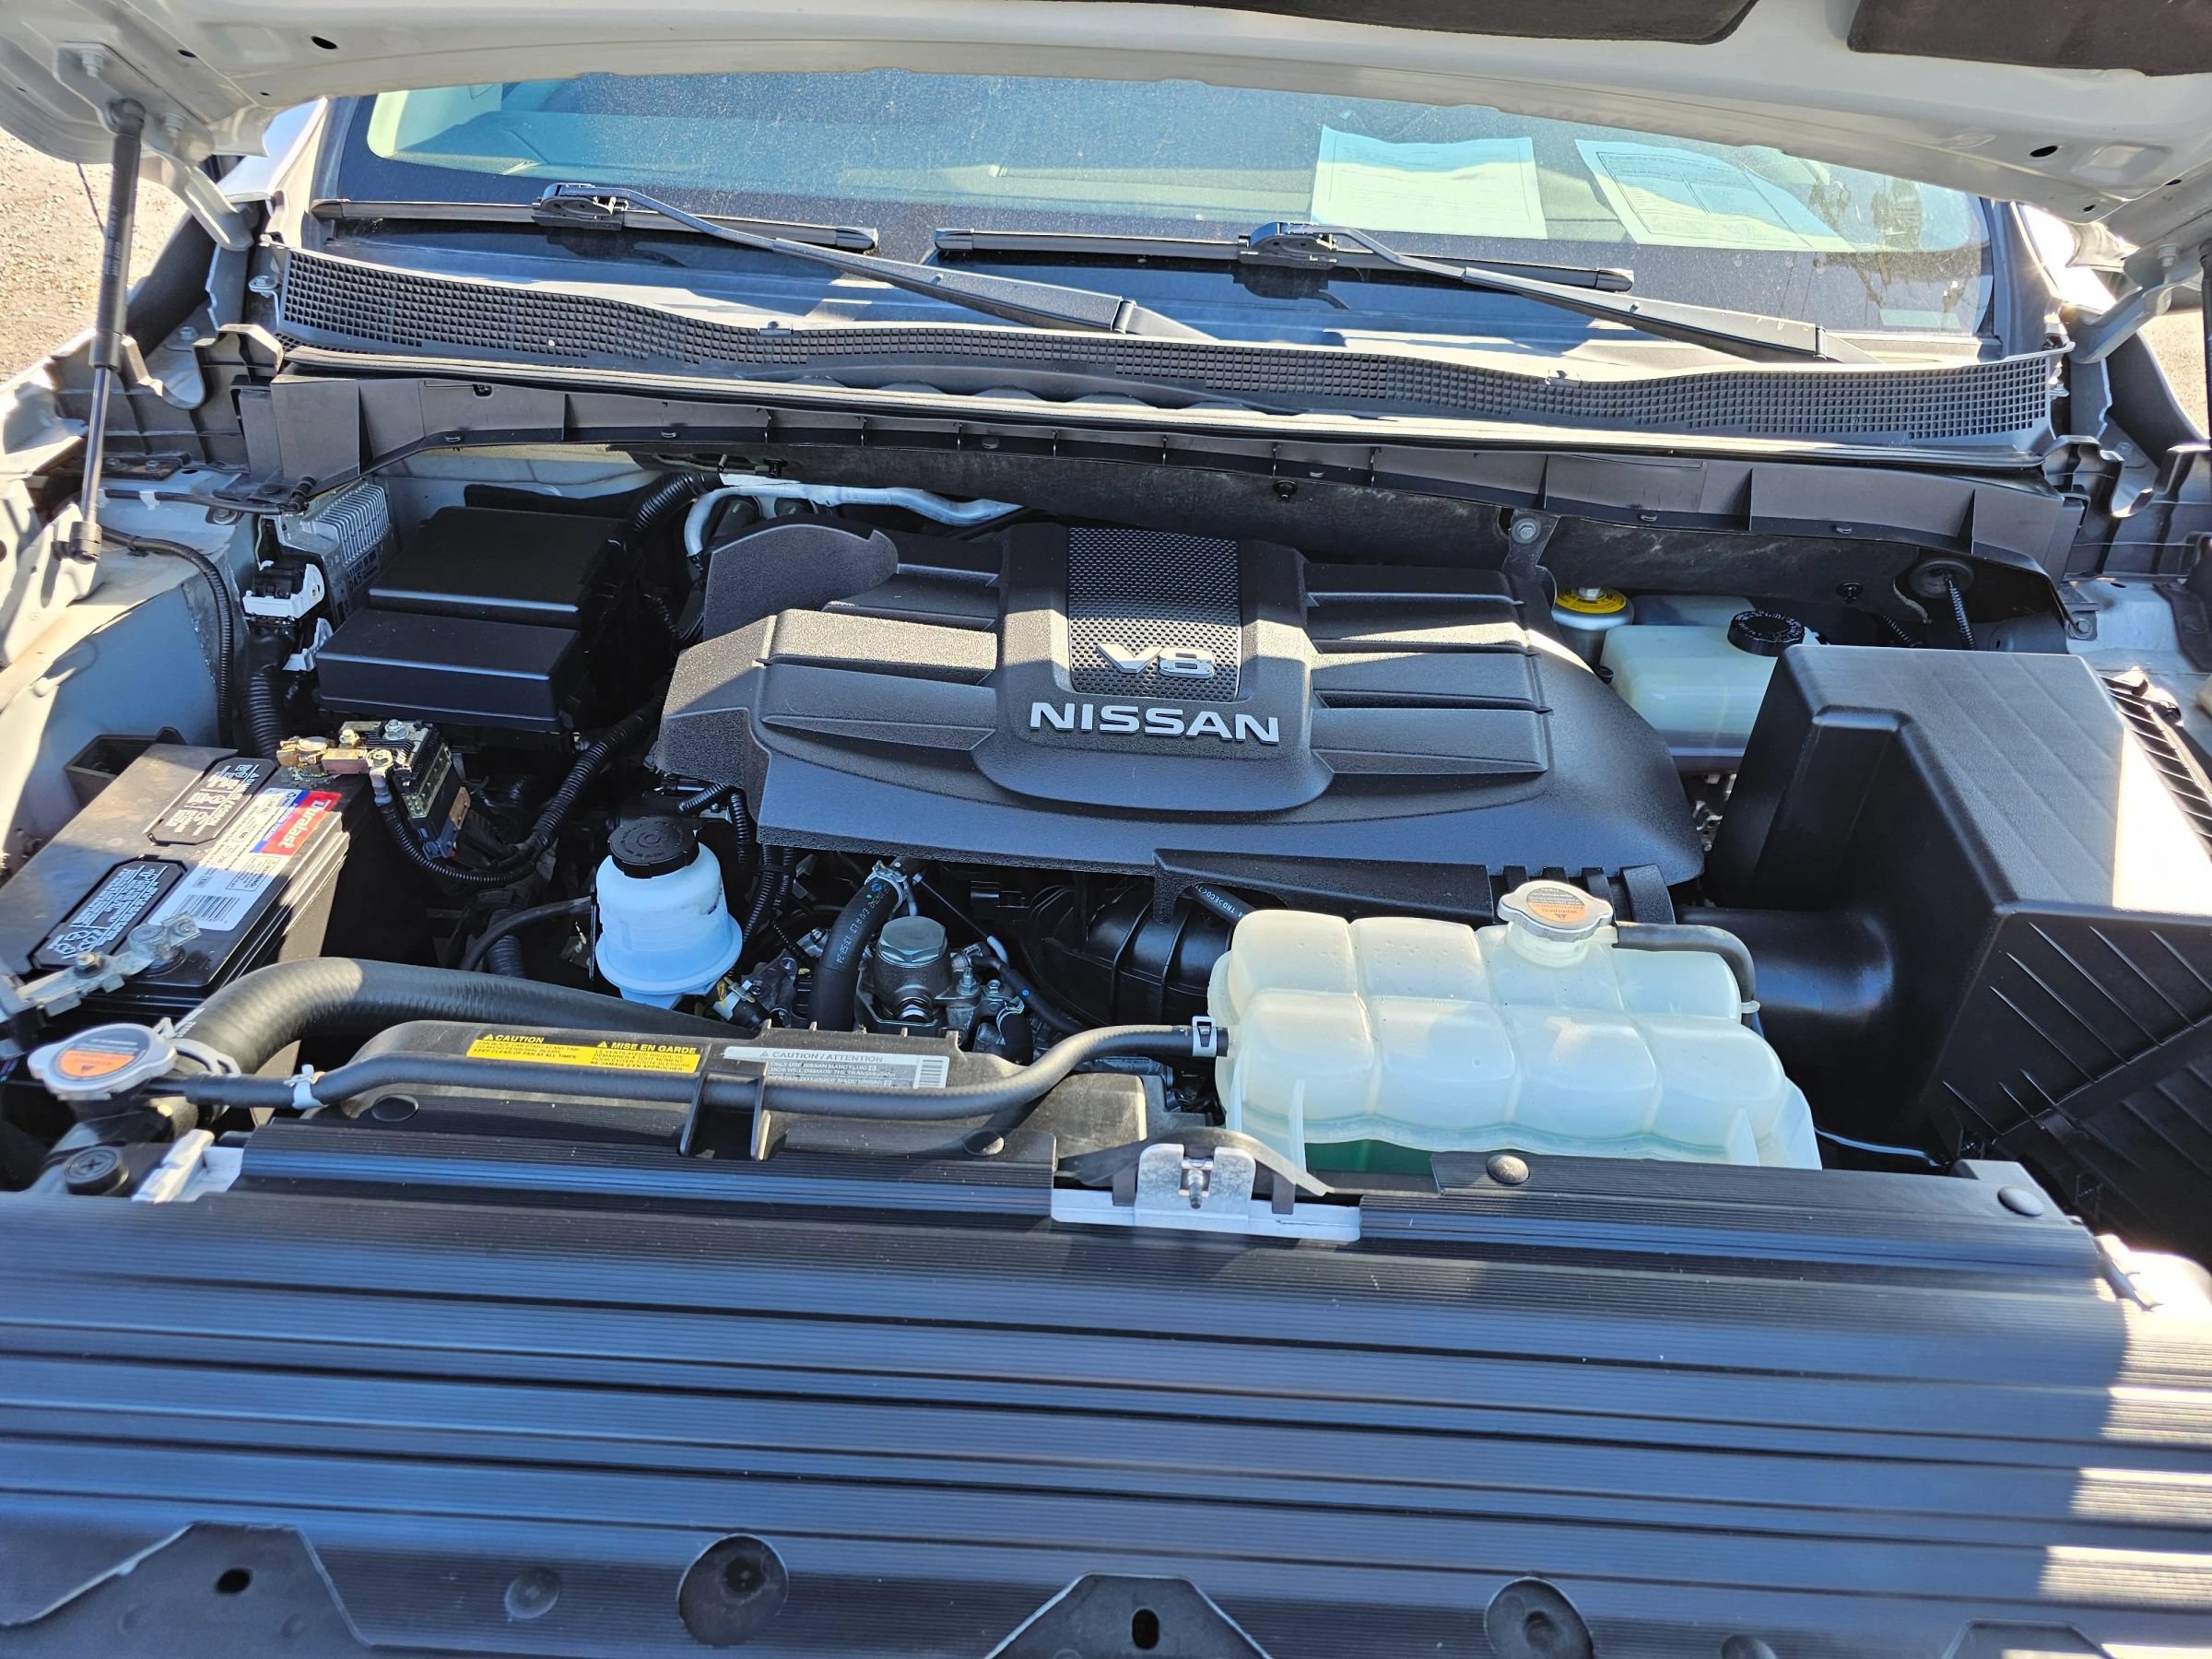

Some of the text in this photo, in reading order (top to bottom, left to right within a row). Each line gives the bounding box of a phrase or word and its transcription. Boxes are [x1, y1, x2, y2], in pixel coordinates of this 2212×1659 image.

[1096, 642, 1216, 680] V8
[1030, 701, 1280, 745] NISSAN
[277, 799, 332, 848] Duralast
[495, 1034, 545, 1043] CAUTION
[611, 1041, 638, 1050] MISE
[658, 1045, 697, 1053] GARDE
[826, 1053, 883, 1062] ATTENTION
